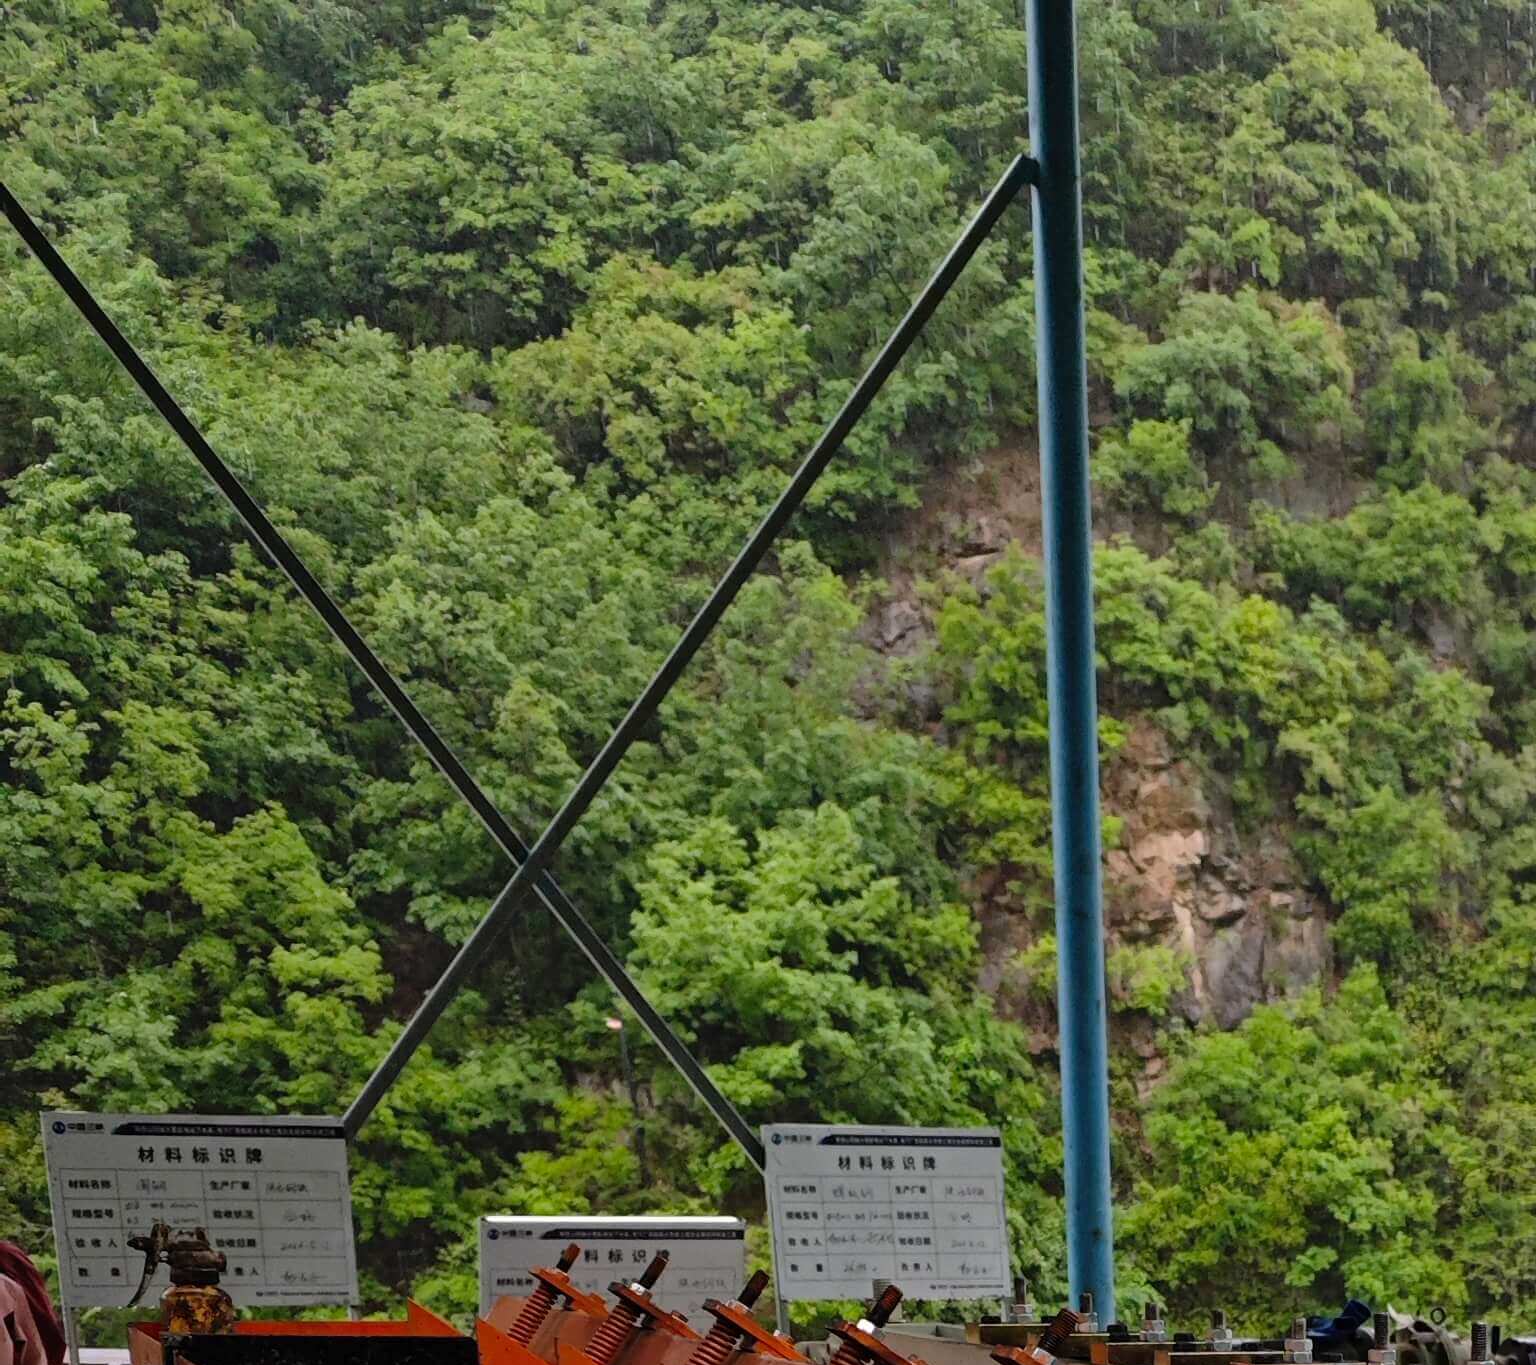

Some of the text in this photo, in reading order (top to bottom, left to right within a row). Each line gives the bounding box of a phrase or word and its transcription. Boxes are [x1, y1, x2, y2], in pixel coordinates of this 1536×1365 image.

[137, 1146, 263, 1165] 材料标识牌
[838, 1155, 936, 1171] 材料标识牌
